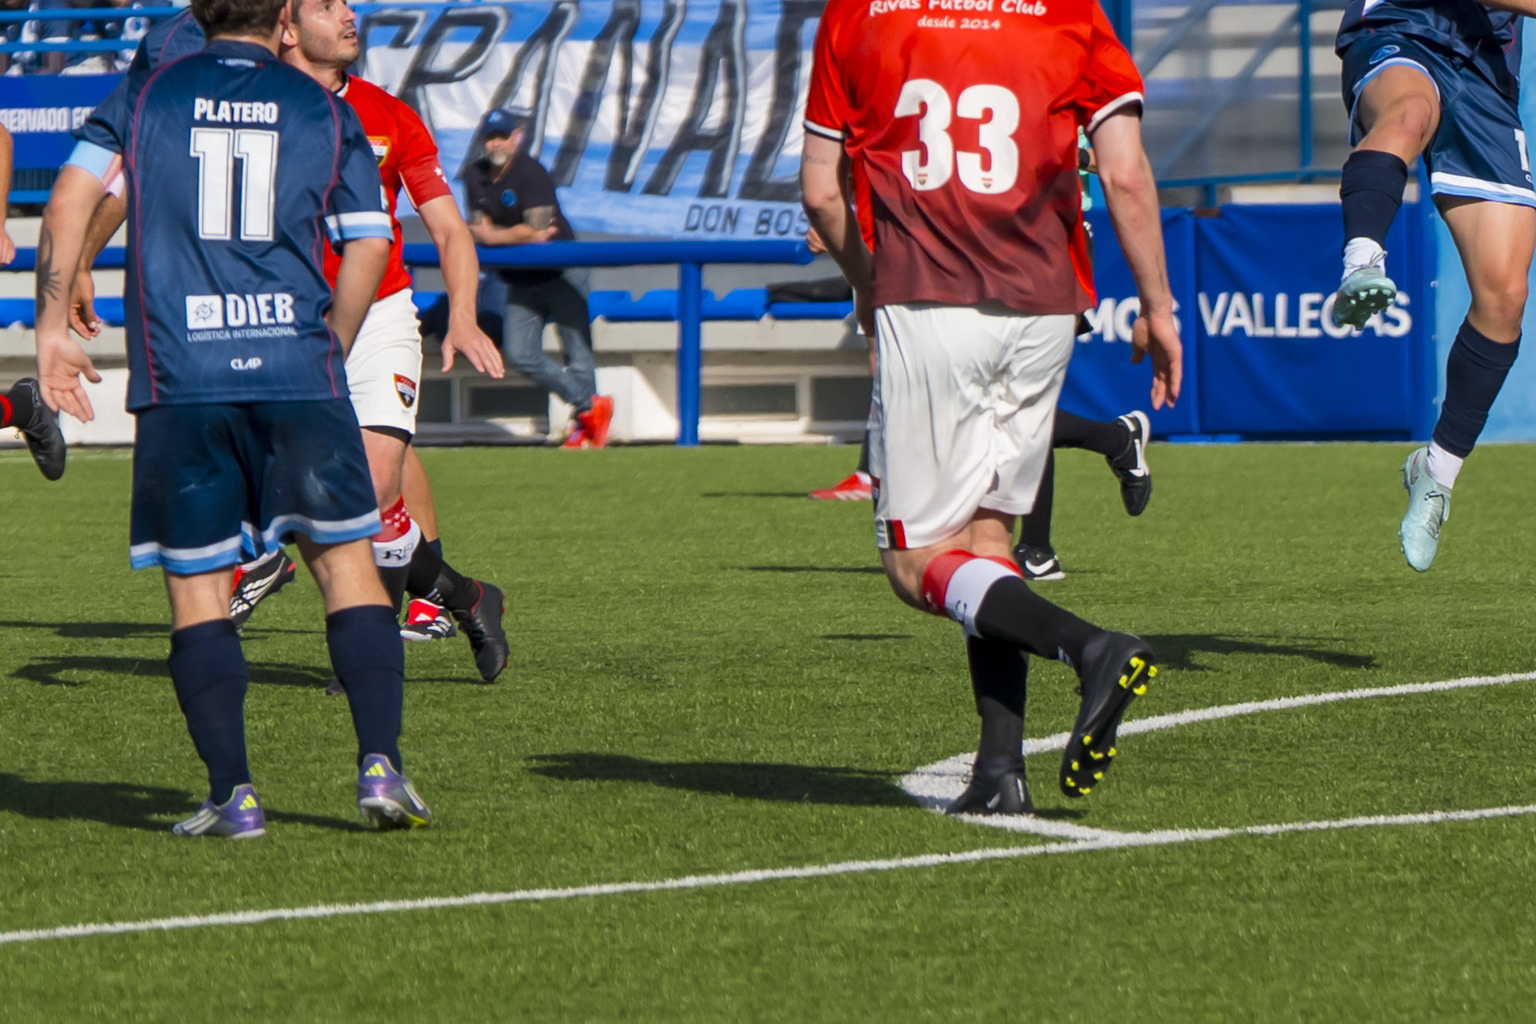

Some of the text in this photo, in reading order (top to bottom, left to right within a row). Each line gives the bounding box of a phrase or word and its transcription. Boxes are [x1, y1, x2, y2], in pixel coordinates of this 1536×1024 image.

[917, 14, 1001, 31] desde 2014
[193, 97, 279, 125] PLATERO
[894, 78, 1020, 195] 33
[189, 127, 279, 242] 11
[684, 204, 741, 234] DON
[225, 293, 295, 327] DIEB
[232, 325, 297, 340] INTERNACIONAL
[230, 357, 263, 371] CLAP
